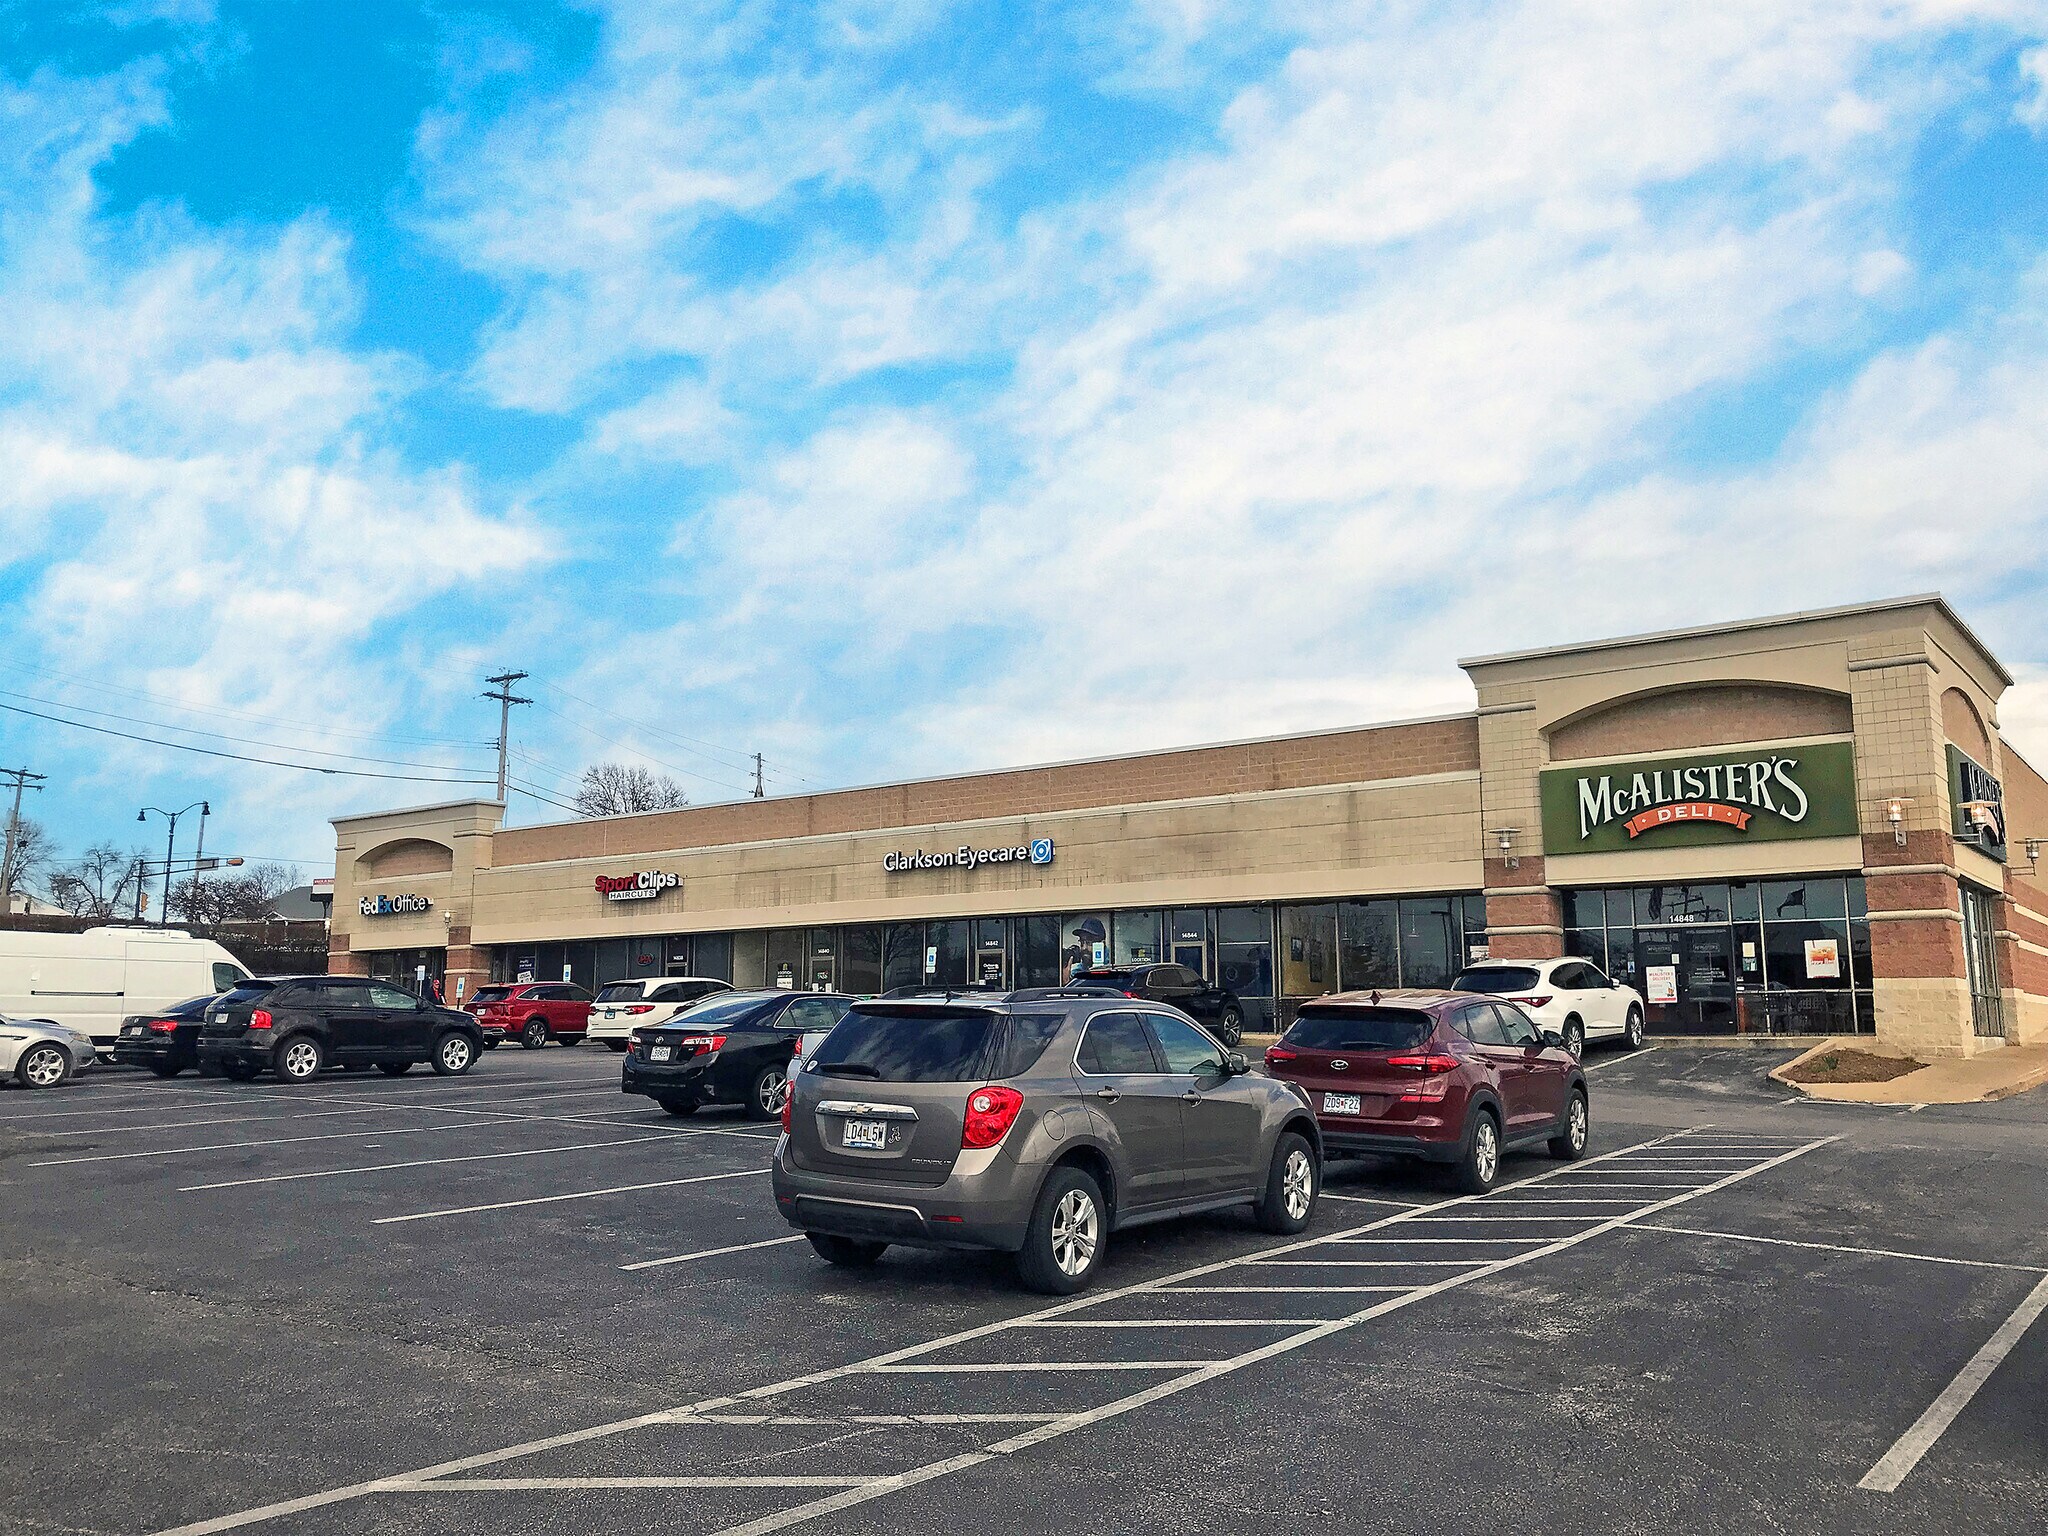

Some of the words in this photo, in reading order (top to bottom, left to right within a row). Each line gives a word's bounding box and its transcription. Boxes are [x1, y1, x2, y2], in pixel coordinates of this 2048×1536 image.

[1658, 806, 1713, 822] DELI
[883, 849, 953, 872] Clarkson
[957, 846, 1027, 870] Eyecare
[609, 889, 655, 900] HAIRCUTS
[393, 894, 426, 913] Office
[1669, 914, 1694, 923] 14848
